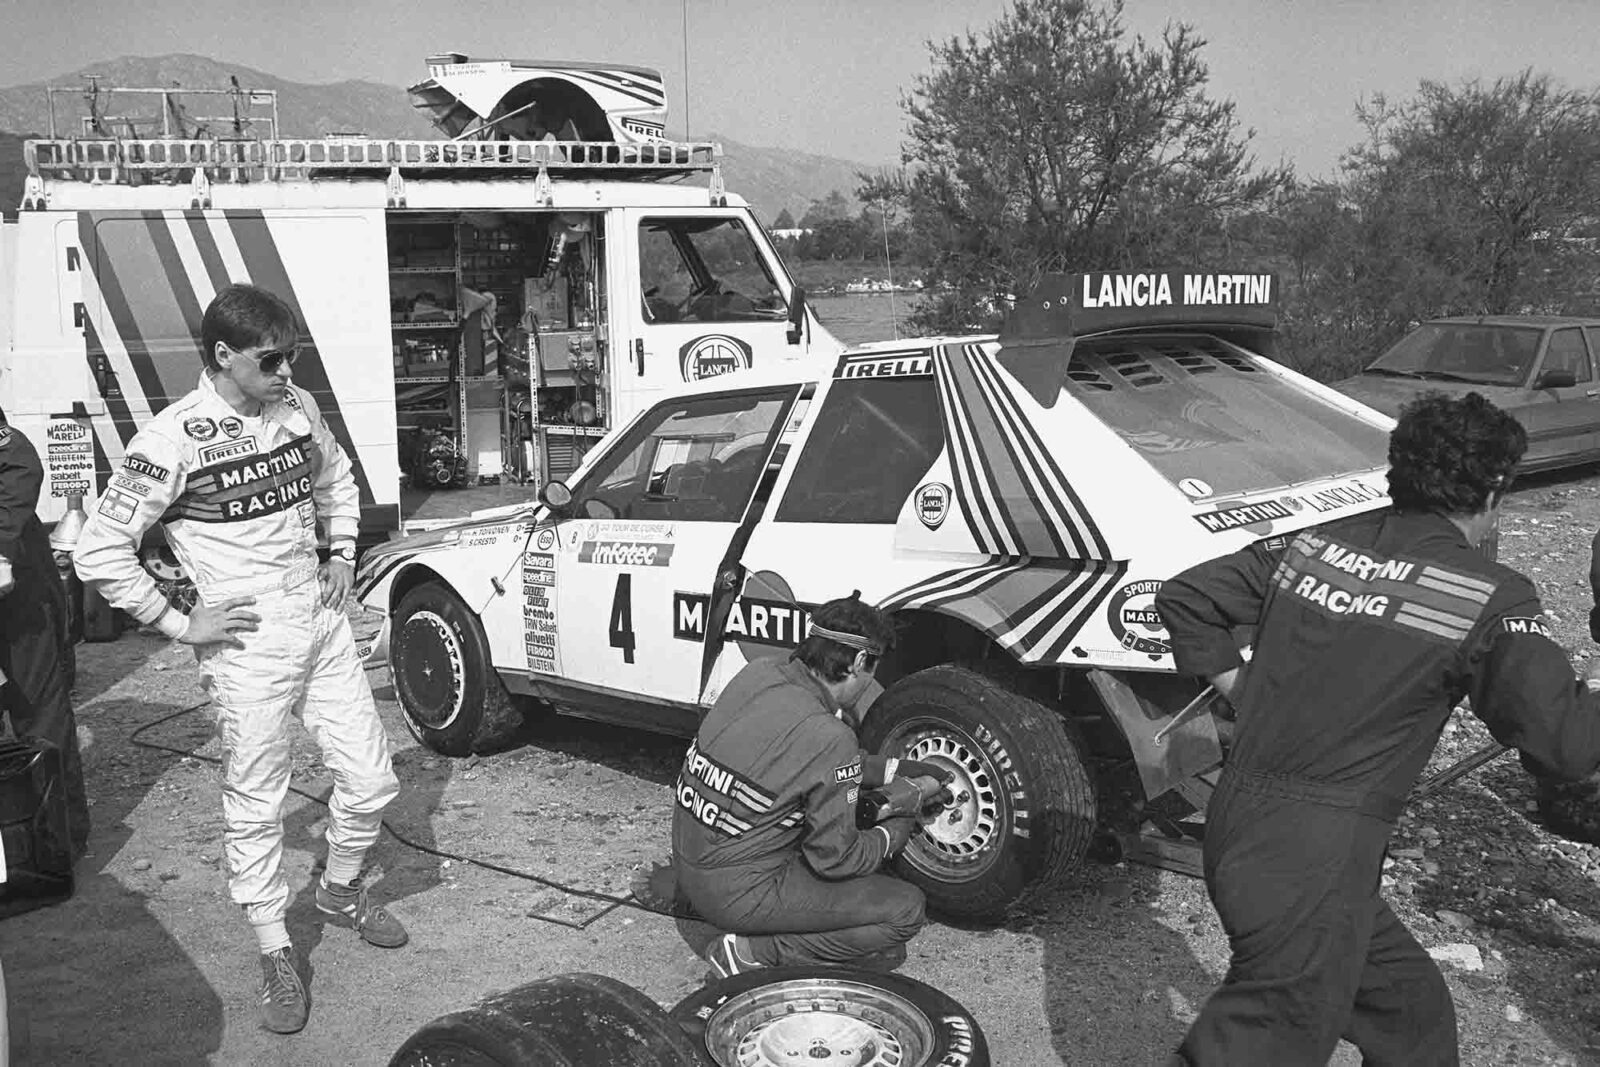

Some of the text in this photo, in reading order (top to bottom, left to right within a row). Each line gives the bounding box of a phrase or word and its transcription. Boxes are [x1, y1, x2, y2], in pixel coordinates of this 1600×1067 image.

[1083, 274, 1271, 308] LANCIA MARTINI
[700, 364, 735, 376] LANCIA
[832, 348, 932, 378] PIRELLI
[204, 439, 255, 464] PIRELLI
[50, 462, 93, 471] brembo
[221, 447, 304, 488] MARTINI
[229, 477, 311, 516] RACING
[1200, 485, 1373, 532] MARTINI LANCIA
[525, 552, 553, 567] Savara
[592, 542, 658, 565] infotec
[524, 605, 554, 620] brembo
[609, 573, 636, 664] 4
[525, 631, 555, 646] olivetti
[528, 645, 553, 659] FERODO
[528, 657, 555, 672] BILSTEIN
[975, 723, 1031, 838] PIRELLI
